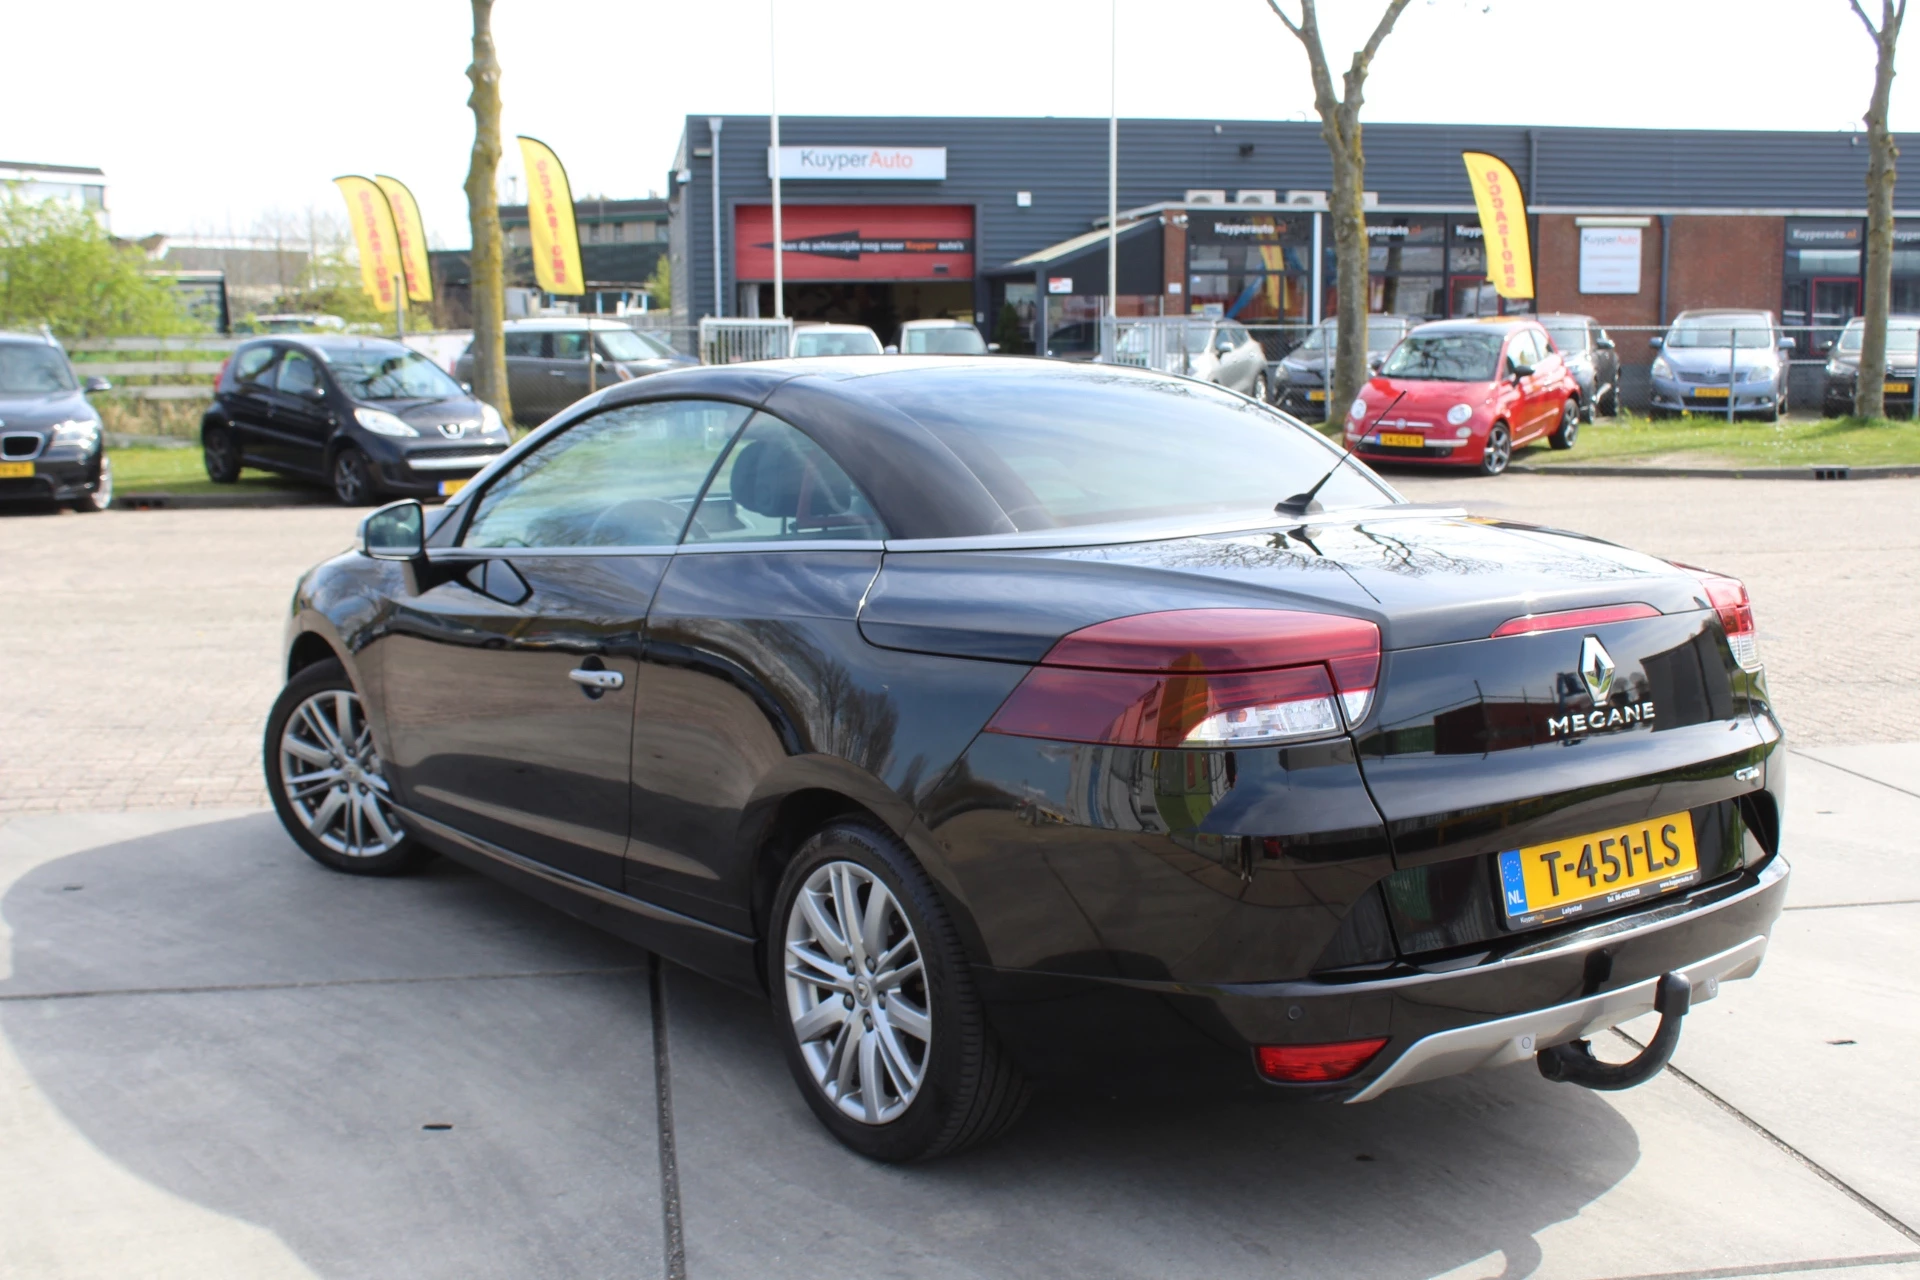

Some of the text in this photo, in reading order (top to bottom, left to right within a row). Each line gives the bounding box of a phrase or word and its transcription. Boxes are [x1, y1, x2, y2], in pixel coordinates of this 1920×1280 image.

[801, 151, 913, 172] KuyperAuto
[1793, 229, 1857, 241] Kuyperauto.nl
[1548, 702, 1655, 736] MEGANE
[1540, 824, 1681, 897] T-451-LS
[1508, 890, 1524, 905] NL
